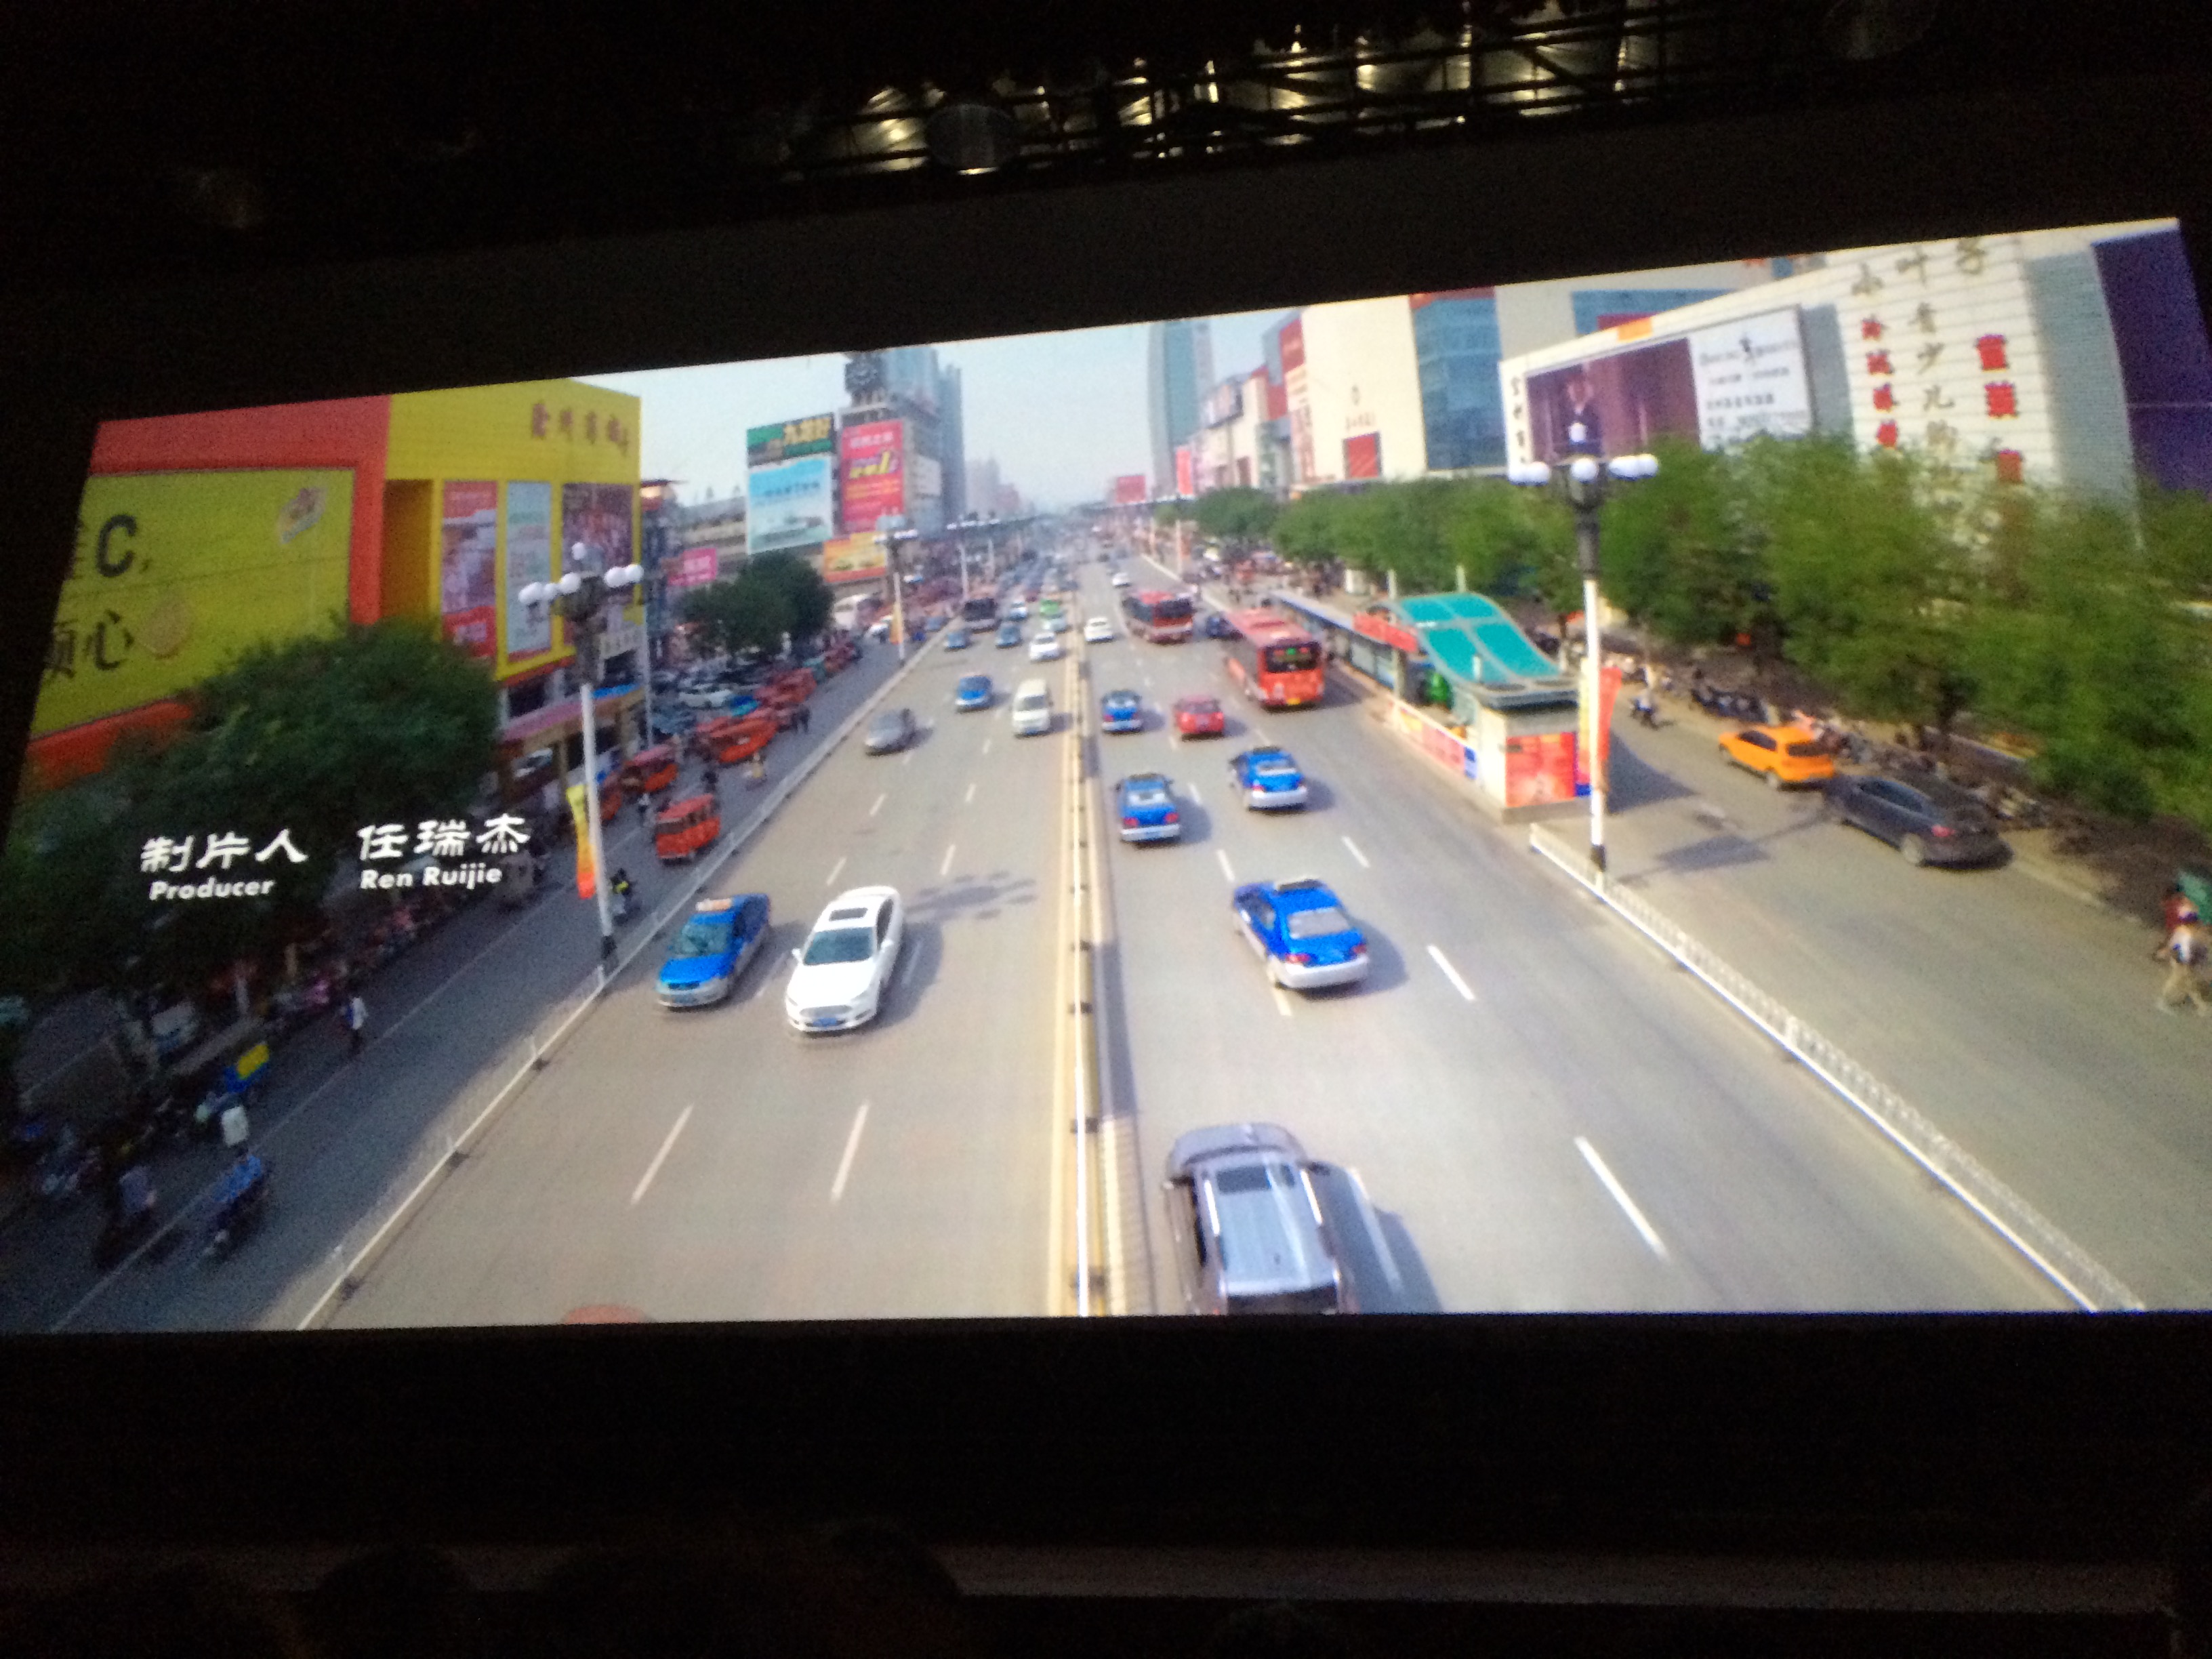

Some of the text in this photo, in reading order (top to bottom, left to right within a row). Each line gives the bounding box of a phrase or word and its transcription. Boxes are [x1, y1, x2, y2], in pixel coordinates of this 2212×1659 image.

[141, 813, 530, 872] 制片人 任瑞杰
[149, 862, 502, 900] Producer Ren Ruijie
